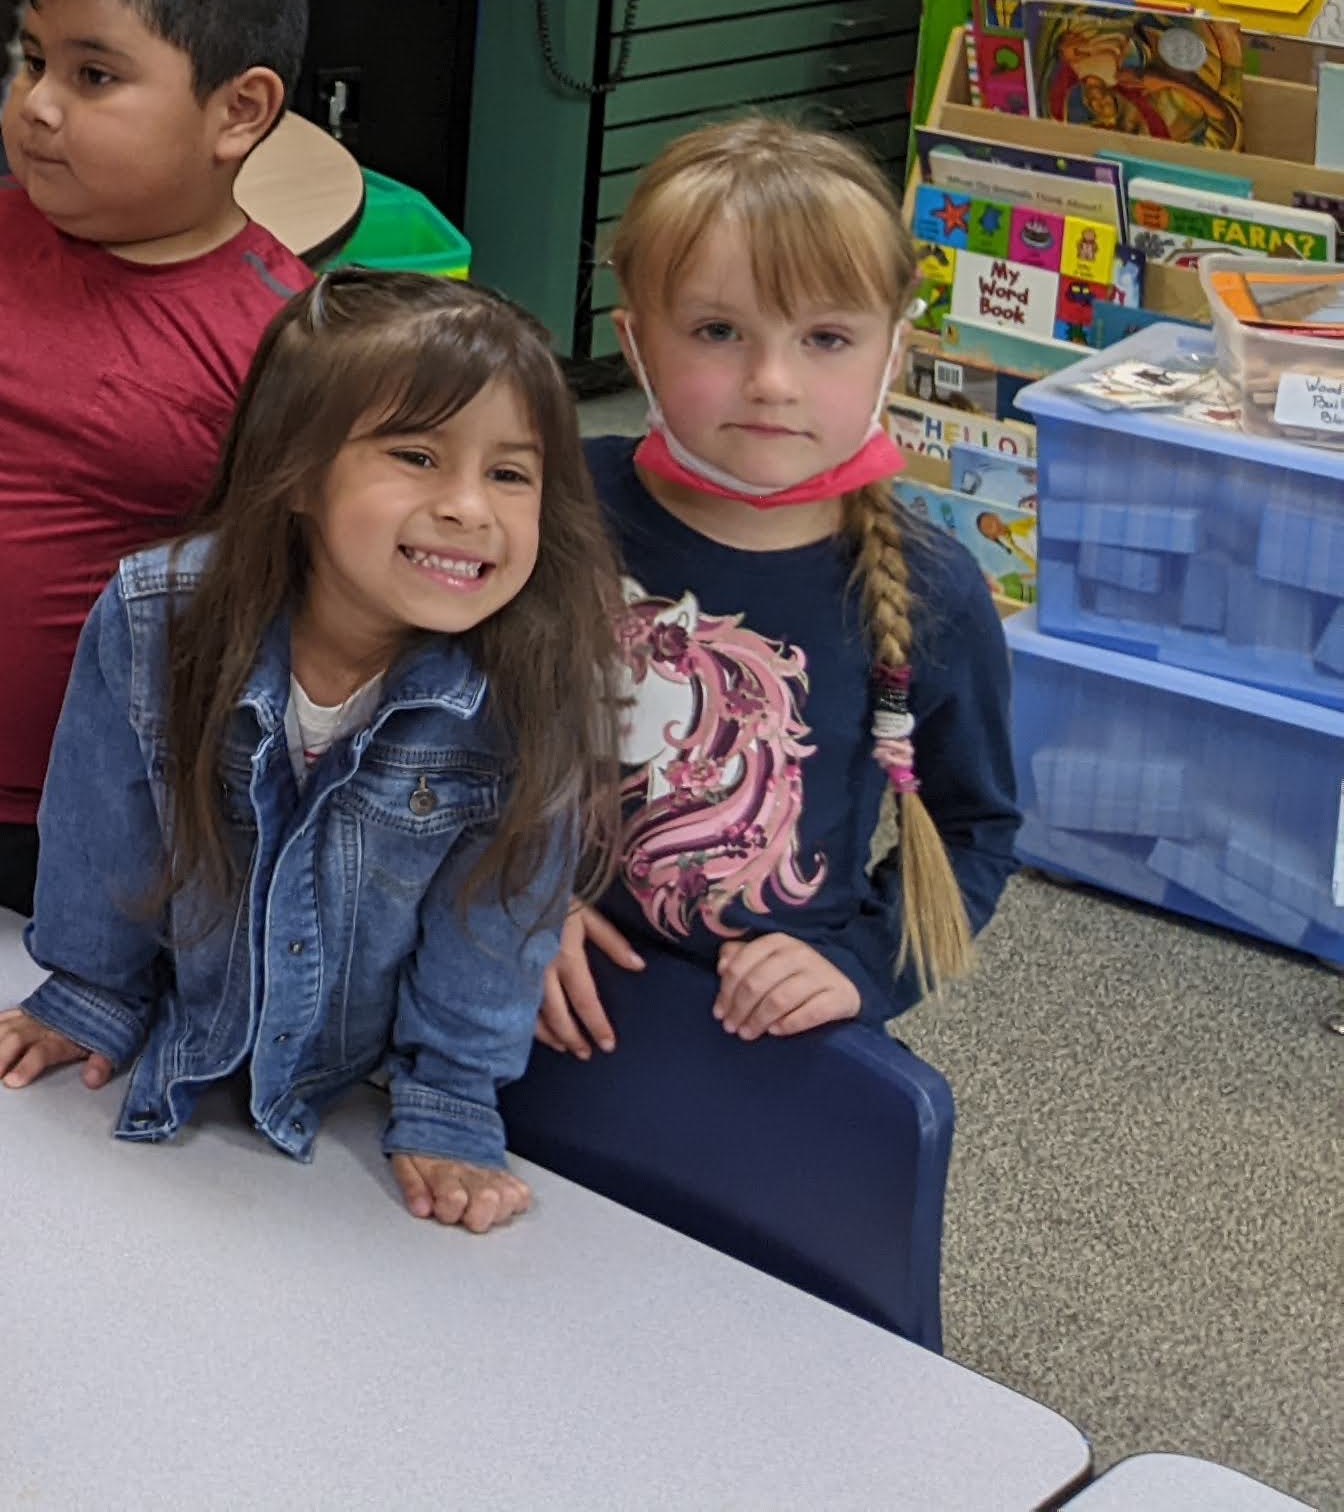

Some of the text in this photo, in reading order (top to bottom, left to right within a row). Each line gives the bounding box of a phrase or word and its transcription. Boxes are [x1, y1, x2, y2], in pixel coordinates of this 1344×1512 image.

[991, 261, 1021, 286] My
[979, 276, 1030, 306] Word
[979, 297, 1025, 324] Book
